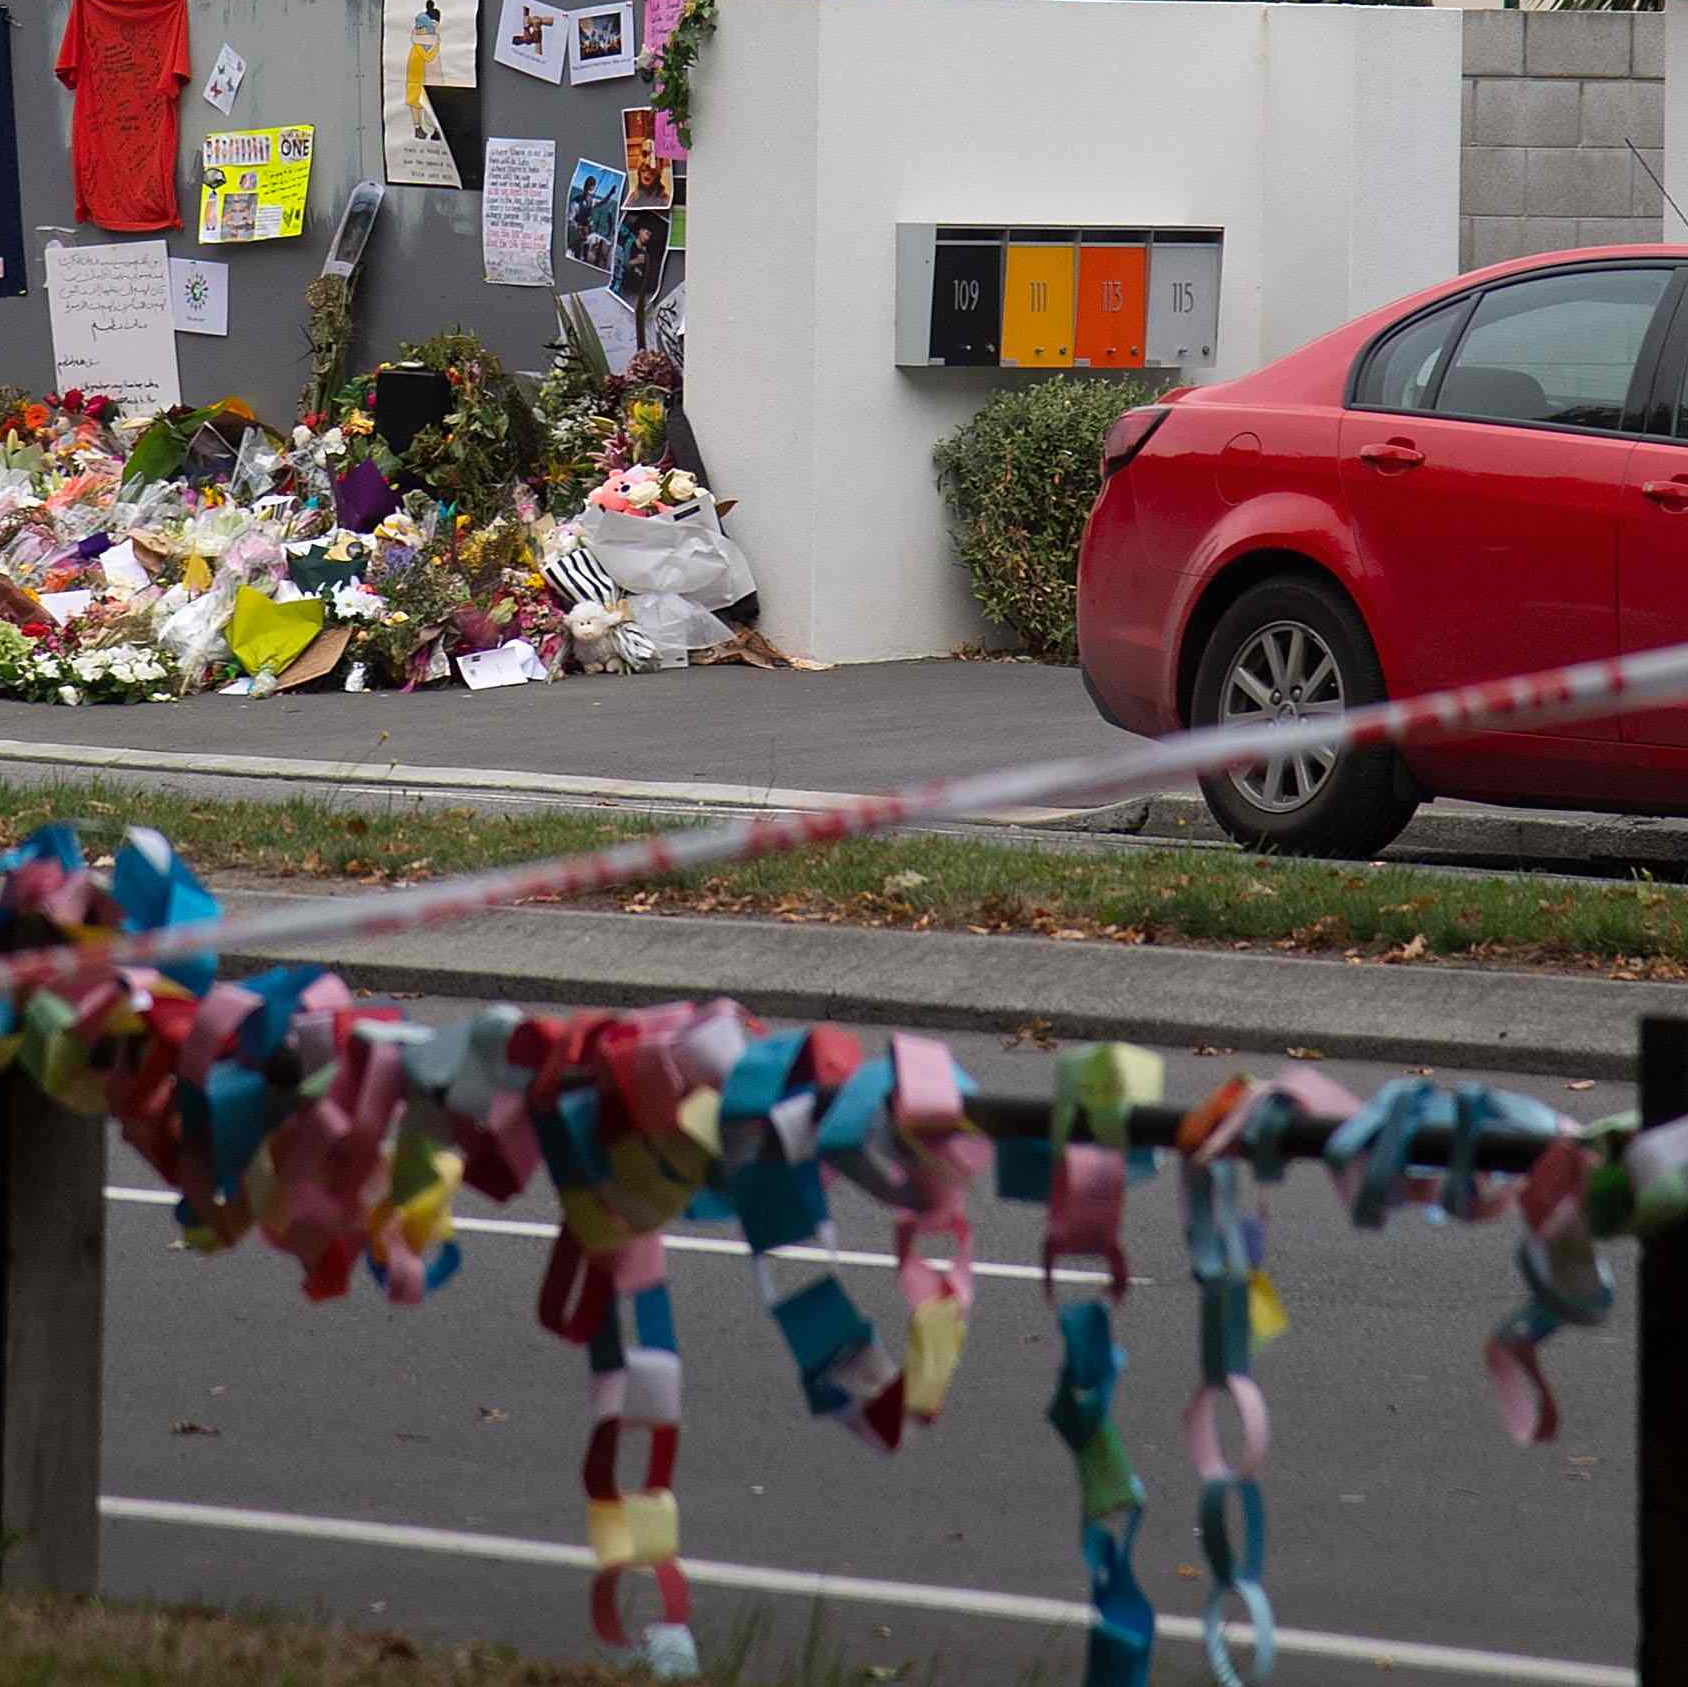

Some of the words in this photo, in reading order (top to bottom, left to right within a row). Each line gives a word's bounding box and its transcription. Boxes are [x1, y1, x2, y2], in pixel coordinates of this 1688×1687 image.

[280, 138, 310, 157] ONE
[953, 280, 979, 311] 109
[1030, 282, 1049, 313] 111
[1101, 281, 1122, 312] 113
[1172, 282, 1194, 313] 115
